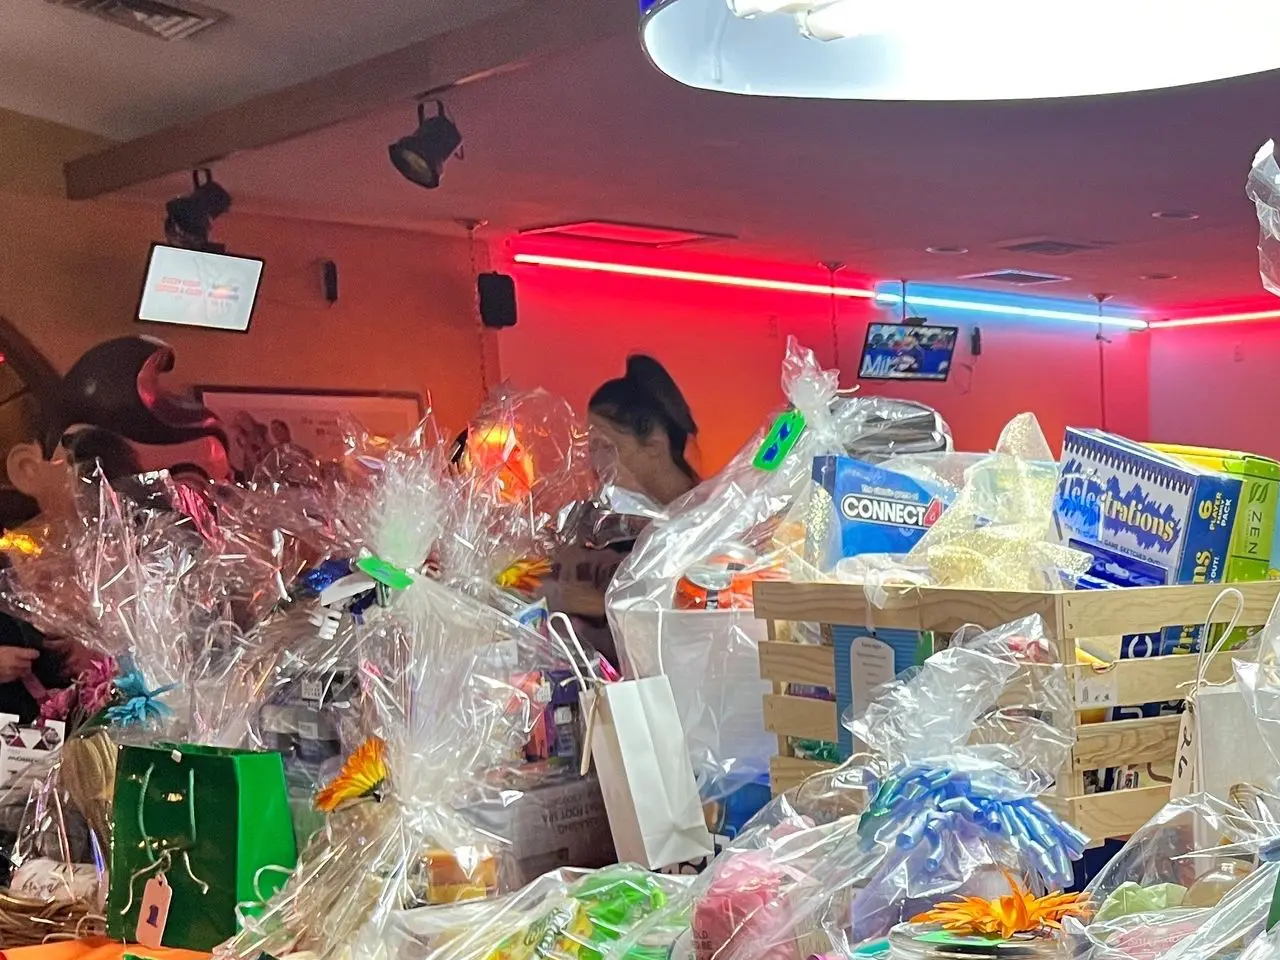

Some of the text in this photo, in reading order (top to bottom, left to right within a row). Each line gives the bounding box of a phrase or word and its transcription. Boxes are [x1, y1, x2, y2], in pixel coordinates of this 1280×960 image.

[843, 496, 926, 526] CONNECT
[1199, 500, 1213, 519] 6
[1209, 492, 1223, 531] PLAYER
[1221, 498, 1233, 527] PACK
[1248, 511, 1263, 554] ZEN
